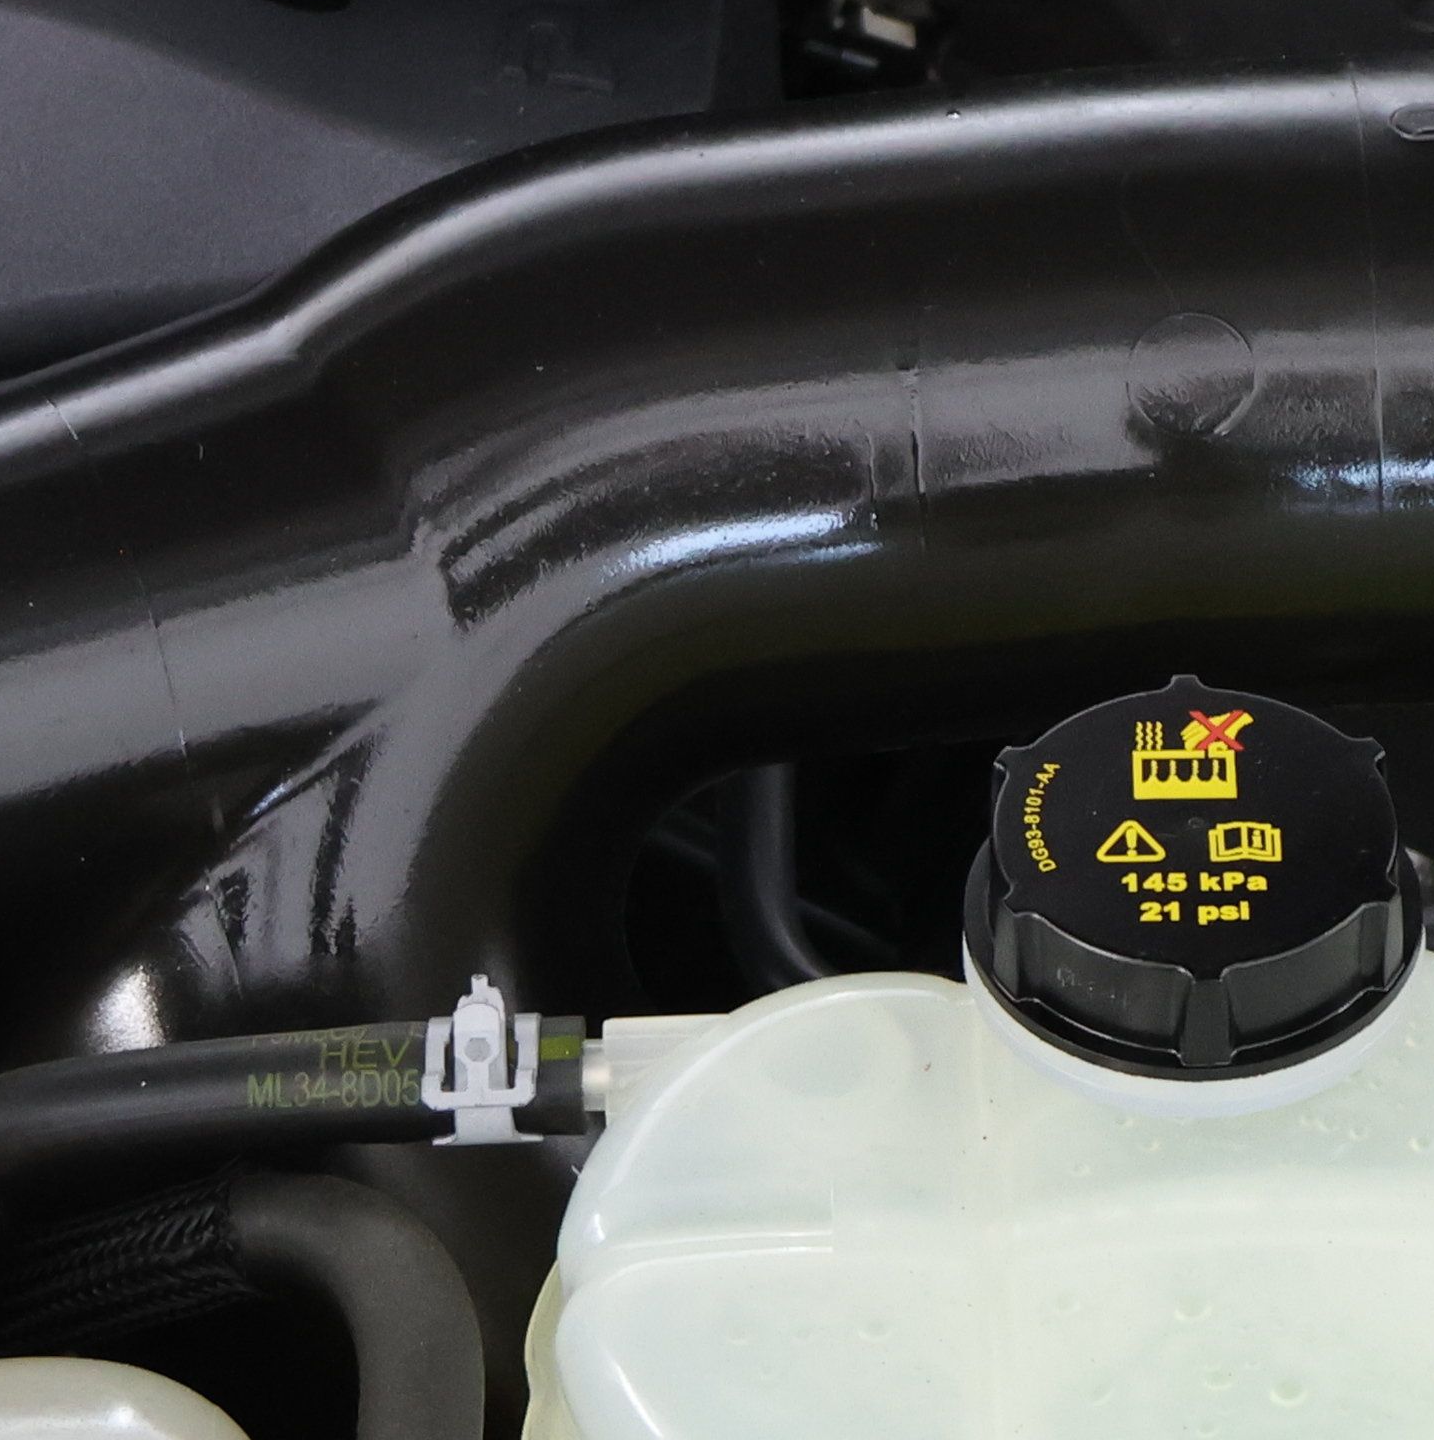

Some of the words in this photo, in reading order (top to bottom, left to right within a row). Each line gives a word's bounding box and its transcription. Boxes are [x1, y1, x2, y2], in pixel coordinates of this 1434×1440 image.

[1023, 762, 1061, 873] DG93-8101-AA
[1120, 871, 1189, 893] 145
[1198, 870, 1269, 892] kPa
[1139, 900, 1181, 923] 21
[1196, 900, 1251, 926] psi
[319, 1038, 412, 1070] HEV
